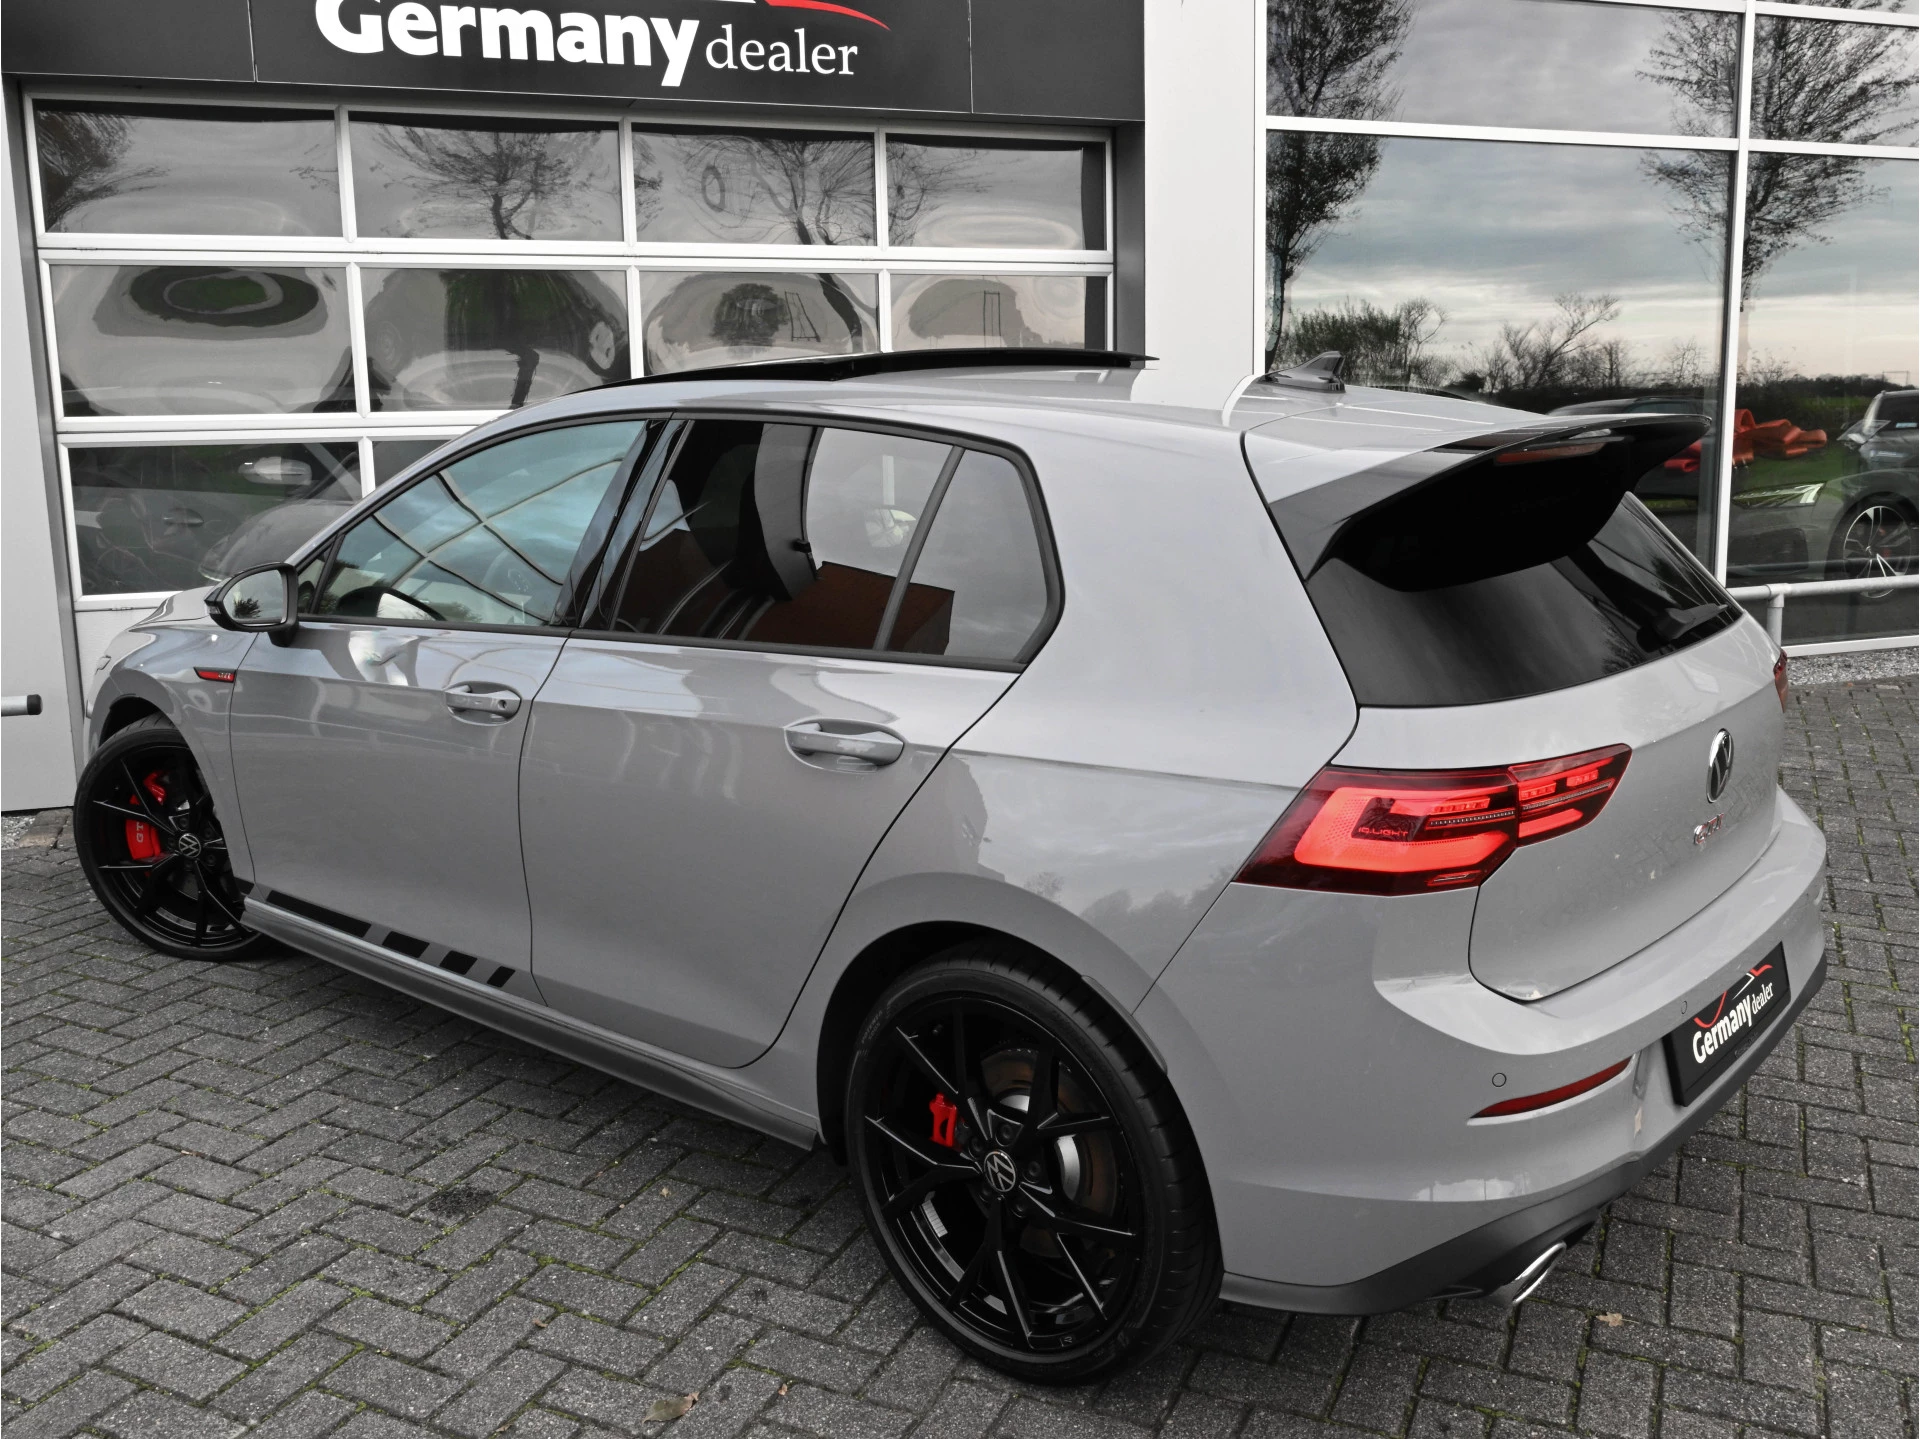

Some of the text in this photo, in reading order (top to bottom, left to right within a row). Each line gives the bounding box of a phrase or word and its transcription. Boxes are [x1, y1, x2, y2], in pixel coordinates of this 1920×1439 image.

[315, 0, 859, 88] Germany dealer
[136, 820, 144, 843] GT
[1692, 994, 1753, 1064] Germany
[1752, 982, 1774, 1015] dealer
